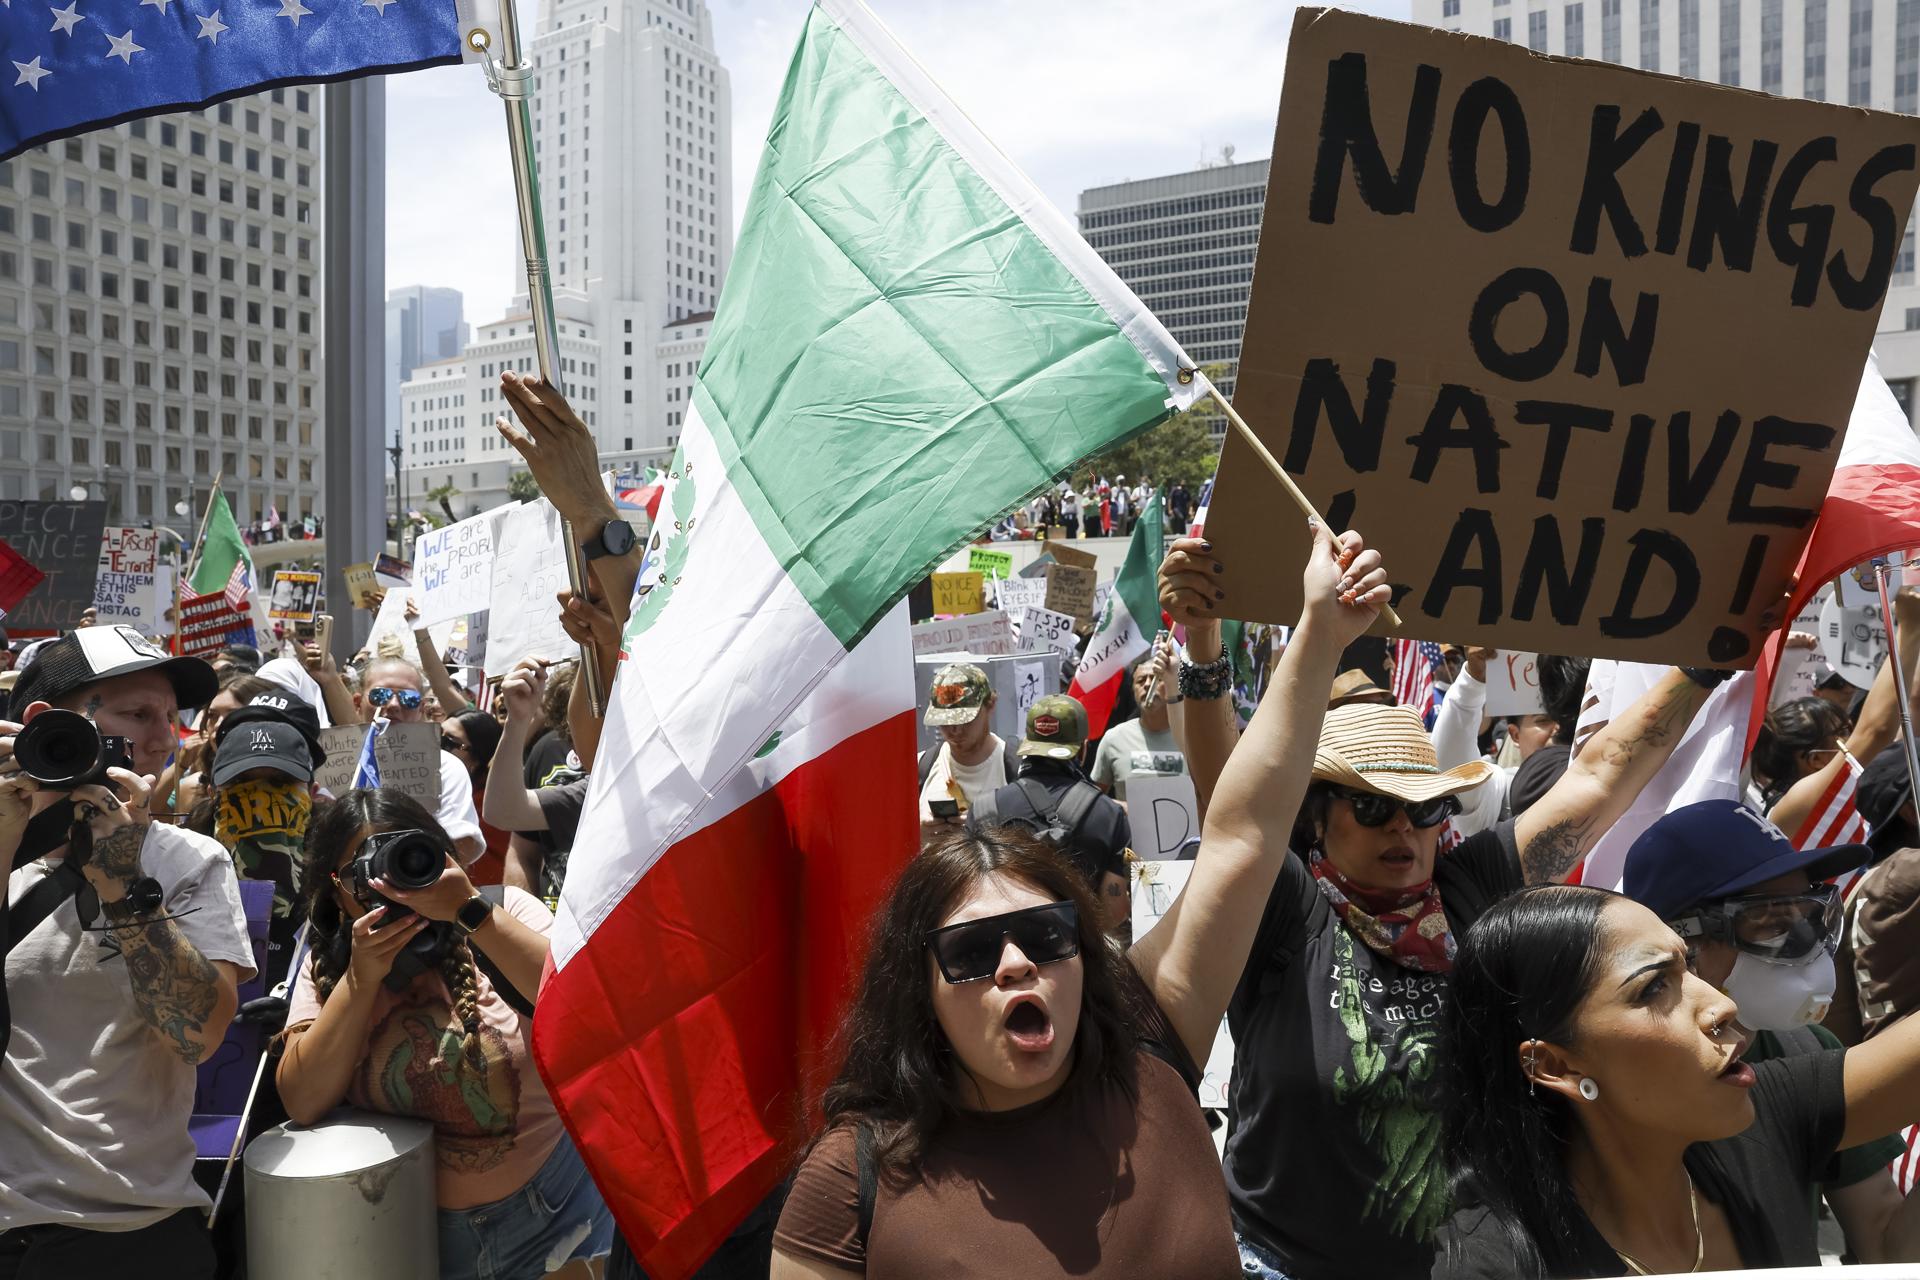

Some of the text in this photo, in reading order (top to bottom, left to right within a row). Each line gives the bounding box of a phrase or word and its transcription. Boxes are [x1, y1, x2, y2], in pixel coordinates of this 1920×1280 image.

[1309, 53, 1917, 311] NO KINGS
[1469, 267, 1659, 387] ON
[1283, 357, 1838, 528] NATIVE
[424, 529, 454, 558] WE
[460, 519, 484, 542] are
[424, 560, 483, 591] WE are
[323, 733, 409, 752] White eople
[393, 751, 427, 764] FIRST
[1330, 963, 1384, 993] rage
[1329, 987, 1373, 1015] the
